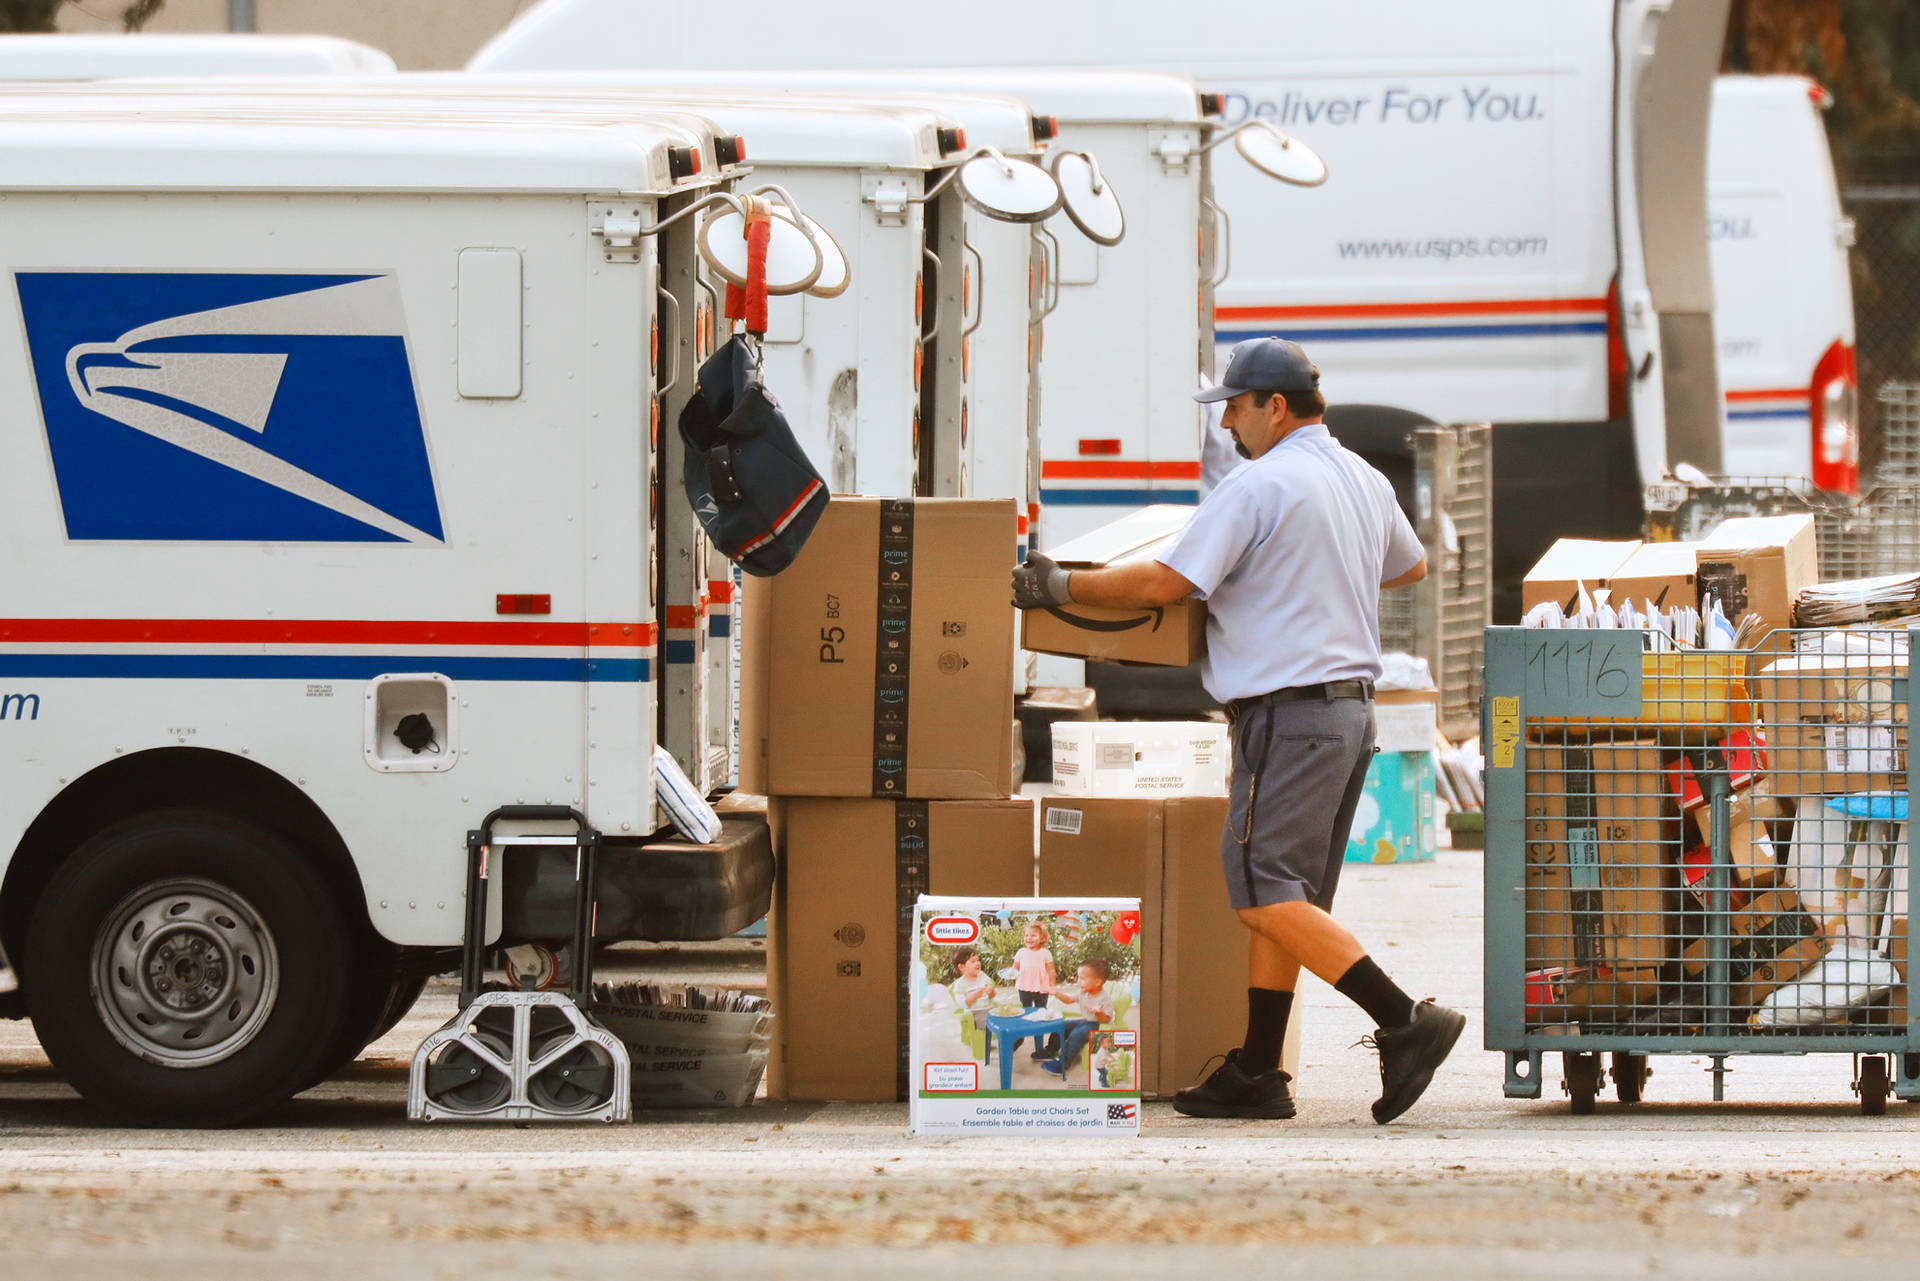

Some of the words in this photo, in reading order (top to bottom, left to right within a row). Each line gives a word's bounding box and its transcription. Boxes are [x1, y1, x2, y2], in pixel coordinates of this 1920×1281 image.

[1222, 91, 1369, 124] Deliver
[1380, 87, 1450, 122] For
[1461, 86, 1545, 121] You.
[1338, 235, 1549, 260] www.usps.com
[884, 550, 908, 559] prime
[826, 593, 840, 619] BC7
[882, 618, 906, 627] prime
[820, 626, 845, 663] P5
[1529, 640, 1630, 698] 1116
[880, 688, 904, 697] prime
[878, 758, 902, 767] prime
[482, 993, 510, 1003] USPS
[610, 1006, 657, 1021] POSTAL
[658, 1011, 709, 1025] SERVICE
[652, 1060, 702, 1072] SERVICE
[976, 1107, 1006, 1115] Garden
[1008, 1107, 1030, 1115] Table
[1031, 1107, 1047, 1115] and
[1049, 1107, 1074, 1115] Chairs
[1076, 1107, 1090, 1115] Set
[962, 1119, 1001, 1127] Ensemble
[1002, 1119, 1024, 1127] table
[1025, 1119, 1035, 1127] et
[1036, 1119, 1065, 1127] chaises
[1067, 1119, 1078, 1127] de
[1080, 1119, 1103, 1128] jardin
